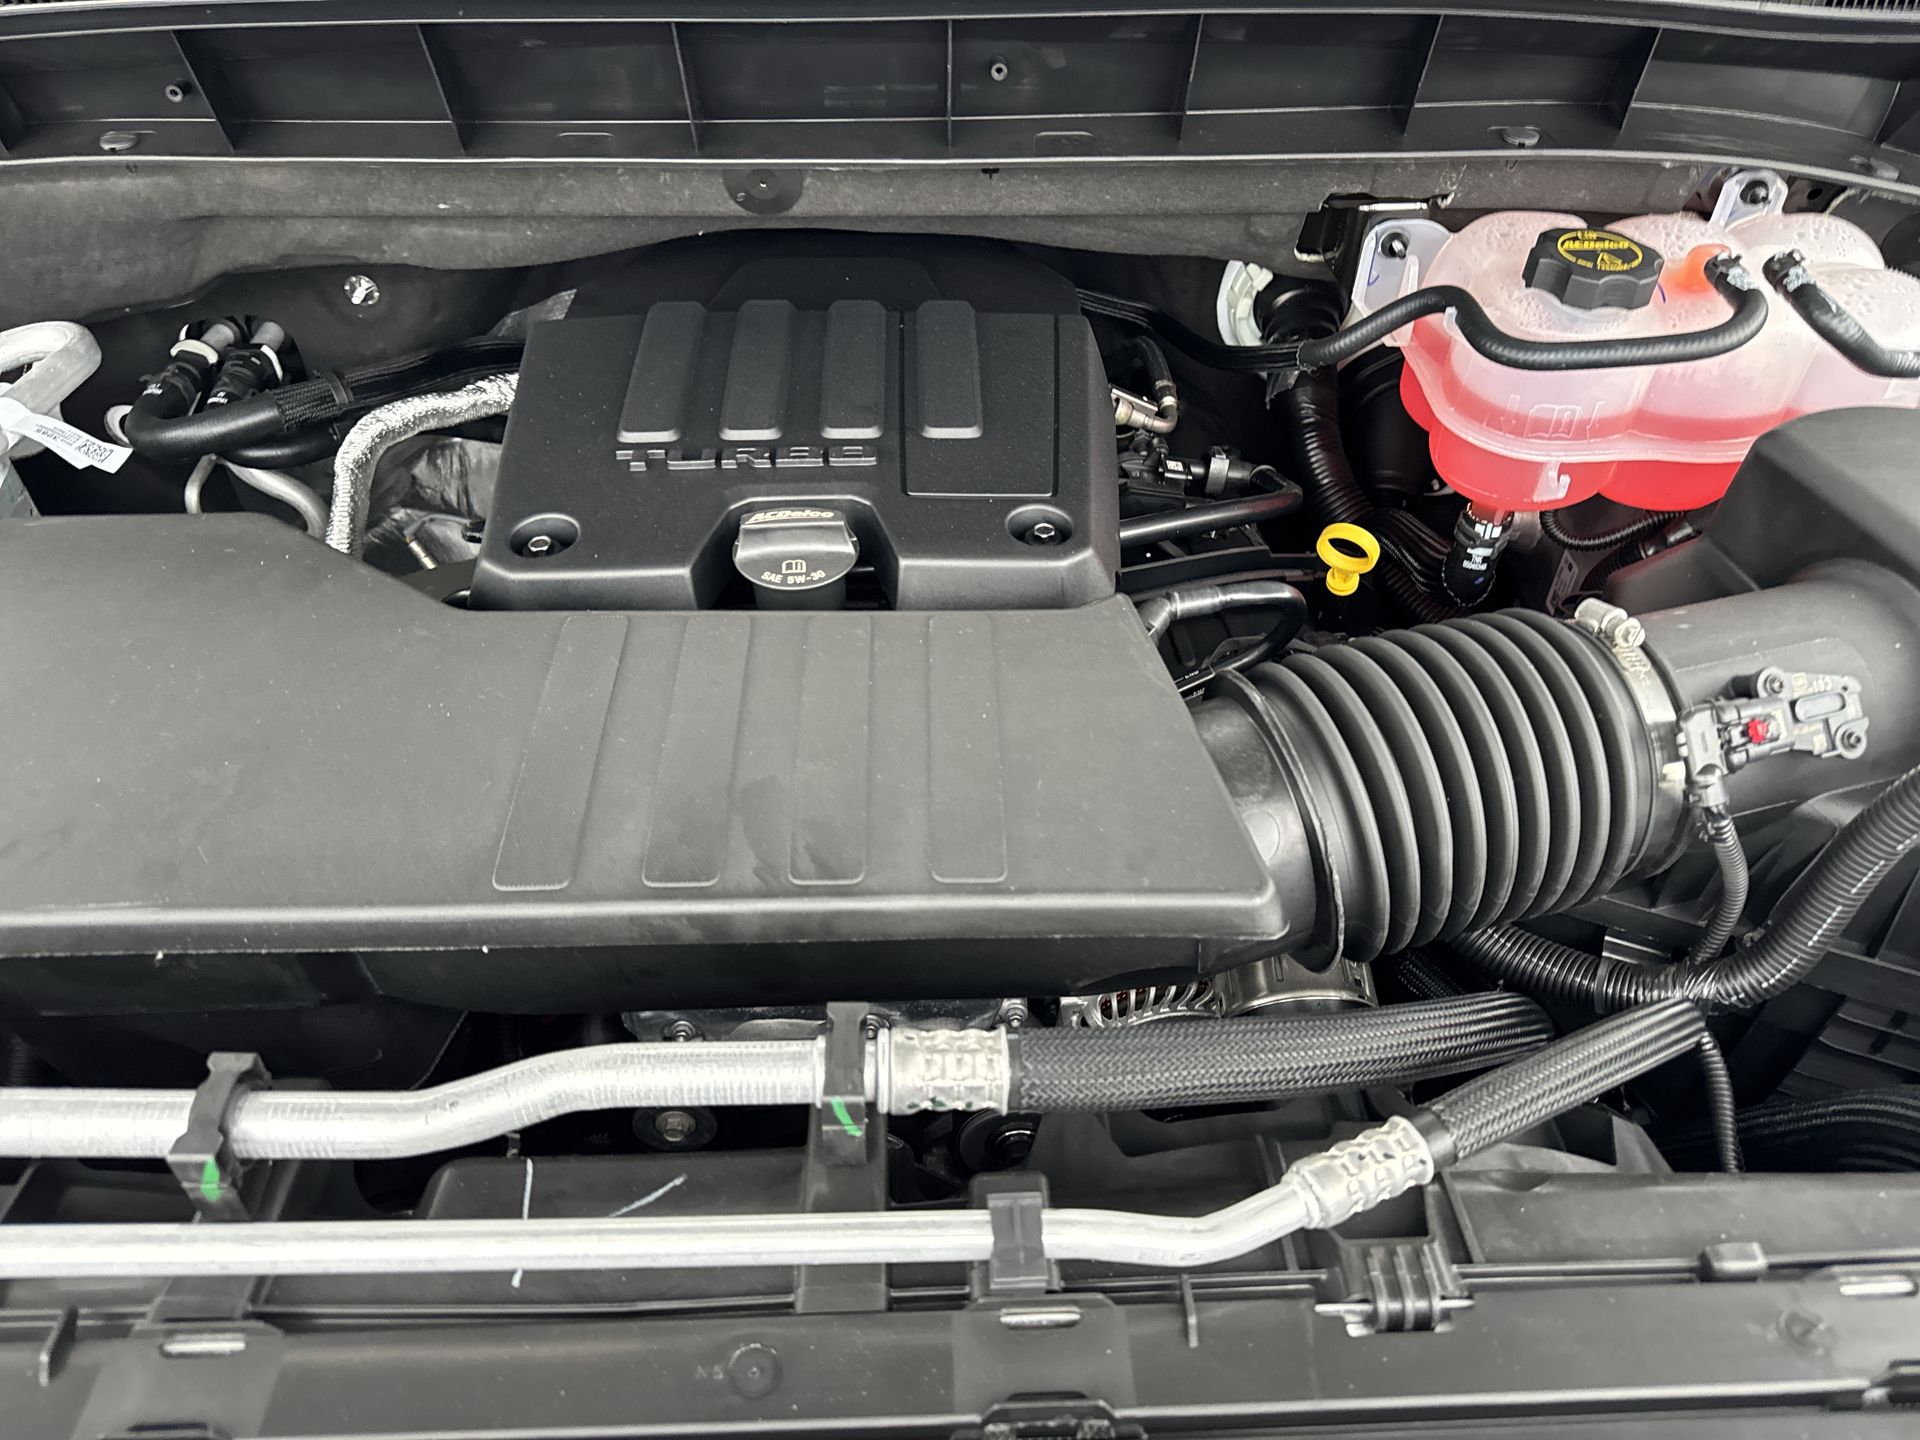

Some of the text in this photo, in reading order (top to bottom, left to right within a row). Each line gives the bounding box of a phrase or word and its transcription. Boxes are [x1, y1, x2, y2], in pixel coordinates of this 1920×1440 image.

[614, 446, 877, 472] TURBO
[745, 509, 834, 524] ACDelco
[761, 570, 826, 584] SAE 5W-30
